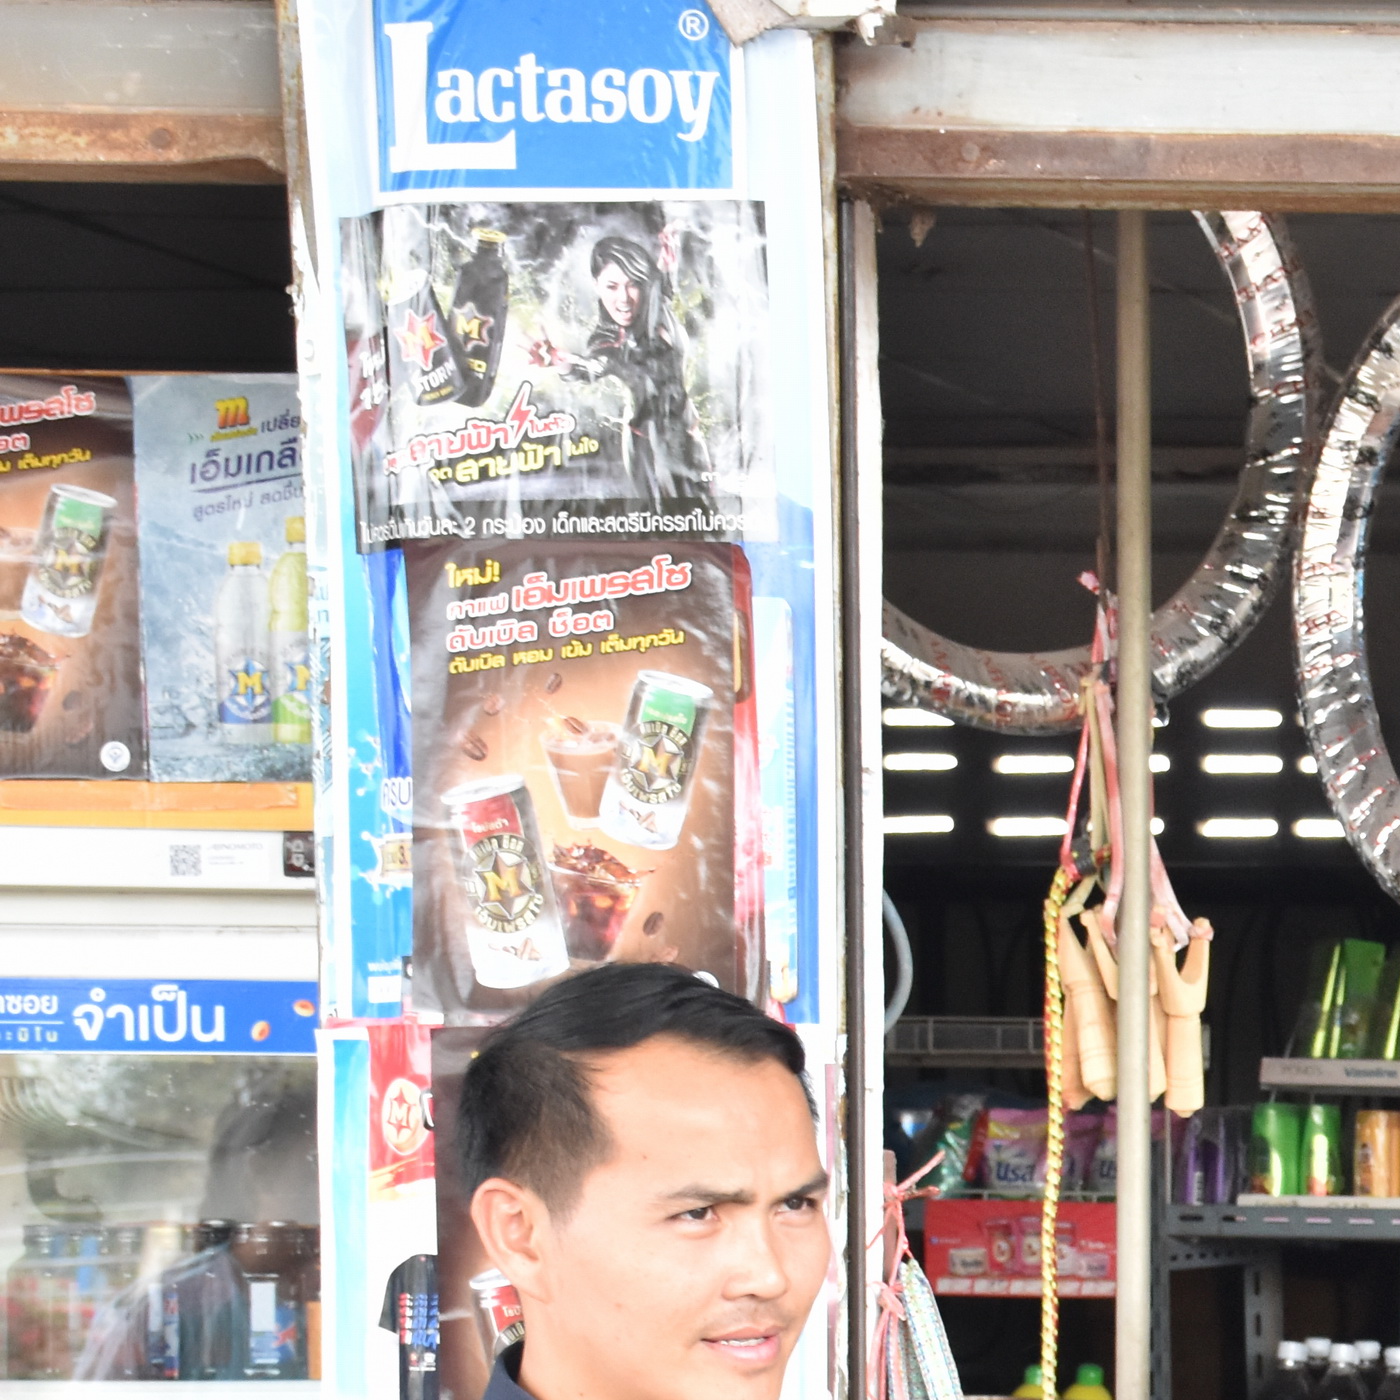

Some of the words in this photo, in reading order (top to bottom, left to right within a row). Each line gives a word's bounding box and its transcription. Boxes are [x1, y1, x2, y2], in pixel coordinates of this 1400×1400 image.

[386, 20, 720, 171] Lactasoy
[455, 442, 562, 483] สายฟ้า
[466, 516, 476, 536] 2
[445, 559, 501, 589] ใหม่!
[447, 592, 510, 621] กาแฟ
[512, 555, 692, 613] เอ็มเพรสโซ
[447, 619, 538, 653] ดับเบิล
[548, 608, 615, 638] ช็อต
[449, 653, 506, 675] ดับเบิล
[513, 648, 554, 666] หอม
[601, 628, 686, 654] เต็มทุกวัน
[72, 984, 226, 1043] จำเป็น
